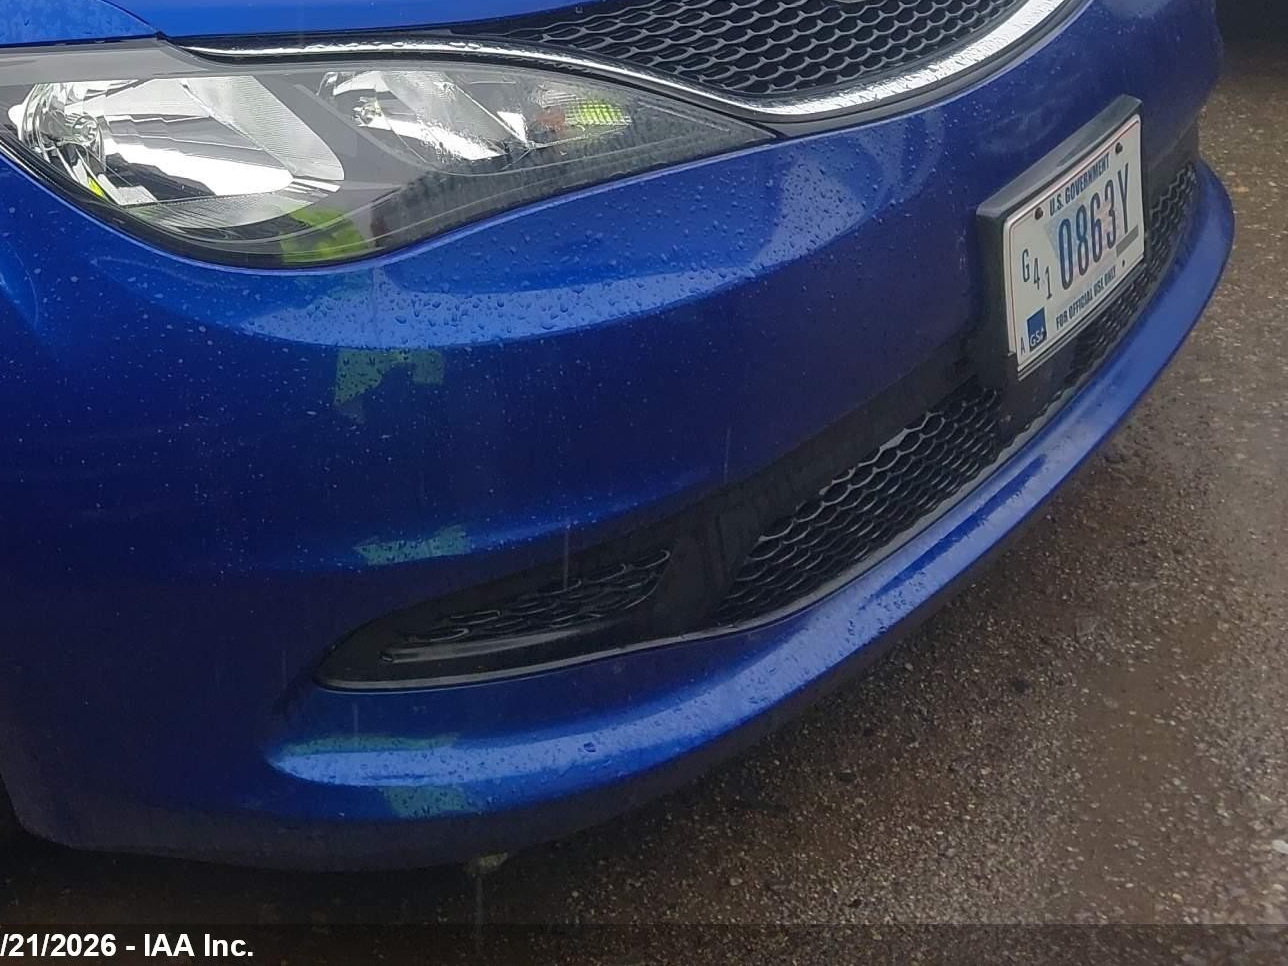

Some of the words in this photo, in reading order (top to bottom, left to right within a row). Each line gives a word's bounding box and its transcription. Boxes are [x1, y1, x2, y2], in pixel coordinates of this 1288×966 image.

[1049, 193, 1064, 217] U.S.
[1065, 152, 1110, 205] GOVERNMENT
[1058, 162, 1129, 291] 0863Y
[1056, 309, 1069, 331] FOR
[1069, 287, 1093, 320] OFFICIAL
[1093, 277, 1105, 298] USE
[1105, 265, 1116, 287] ONLY
